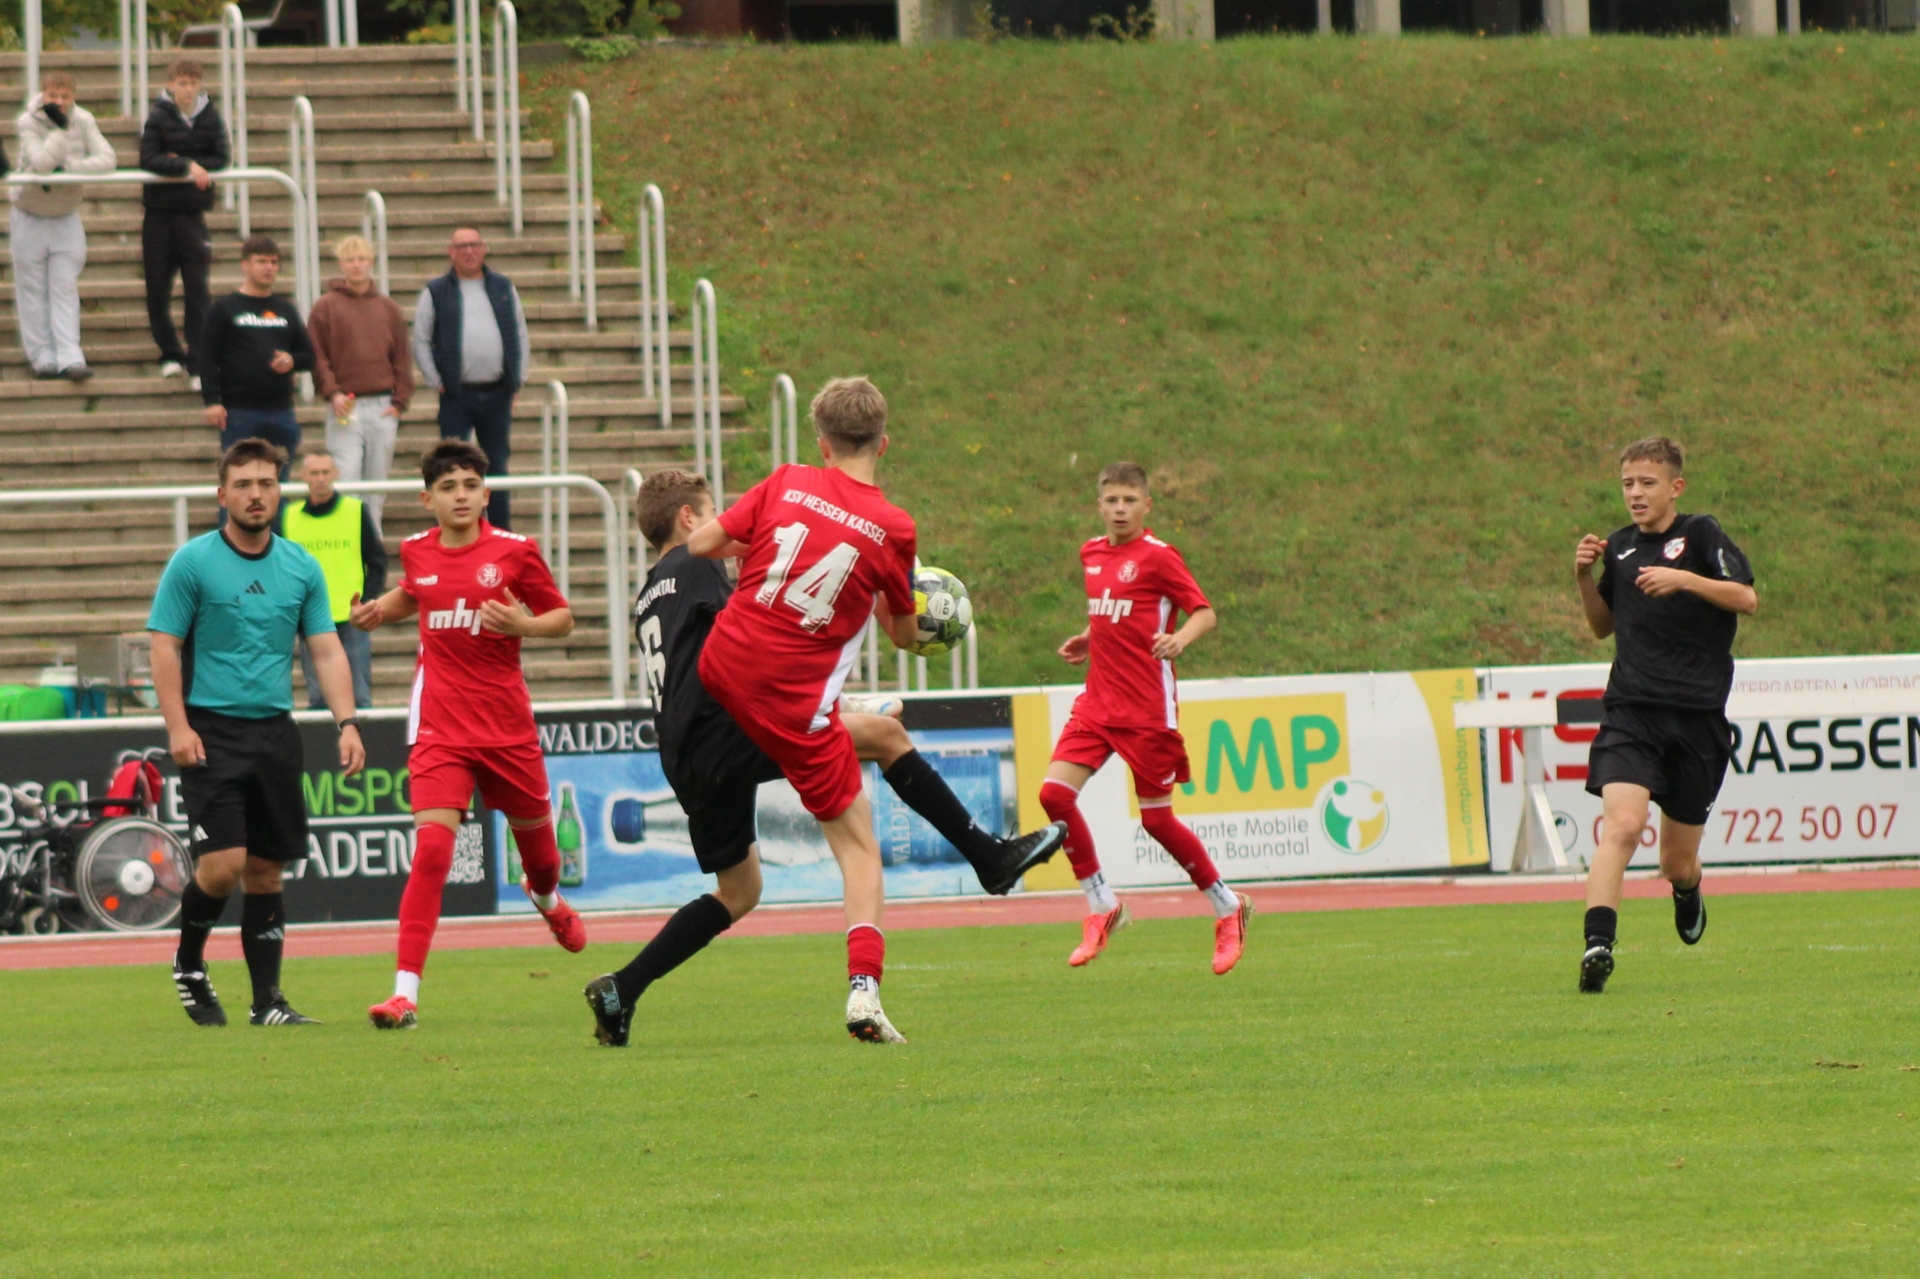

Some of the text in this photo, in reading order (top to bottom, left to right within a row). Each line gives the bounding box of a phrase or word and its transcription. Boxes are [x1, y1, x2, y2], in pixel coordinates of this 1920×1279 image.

[783, 489, 887, 546] KSV HESSEN KASSEL
[755, 521, 860, 634] 14
[1088, 588, 1133, 624] mhp
[640, 614, 666, 713] 6
[1178, 714, 1340, 796] MP
[1226, 836, 1310, 860] Baunatal
[1245, 814, 1309, 837] Mobile
[1721, 807, 1785, 845] 722
[1800, 804, 1842, 841] 50
[1857, 803, 1898, 839] 07
[282, 829, 416, 880] ADEN
